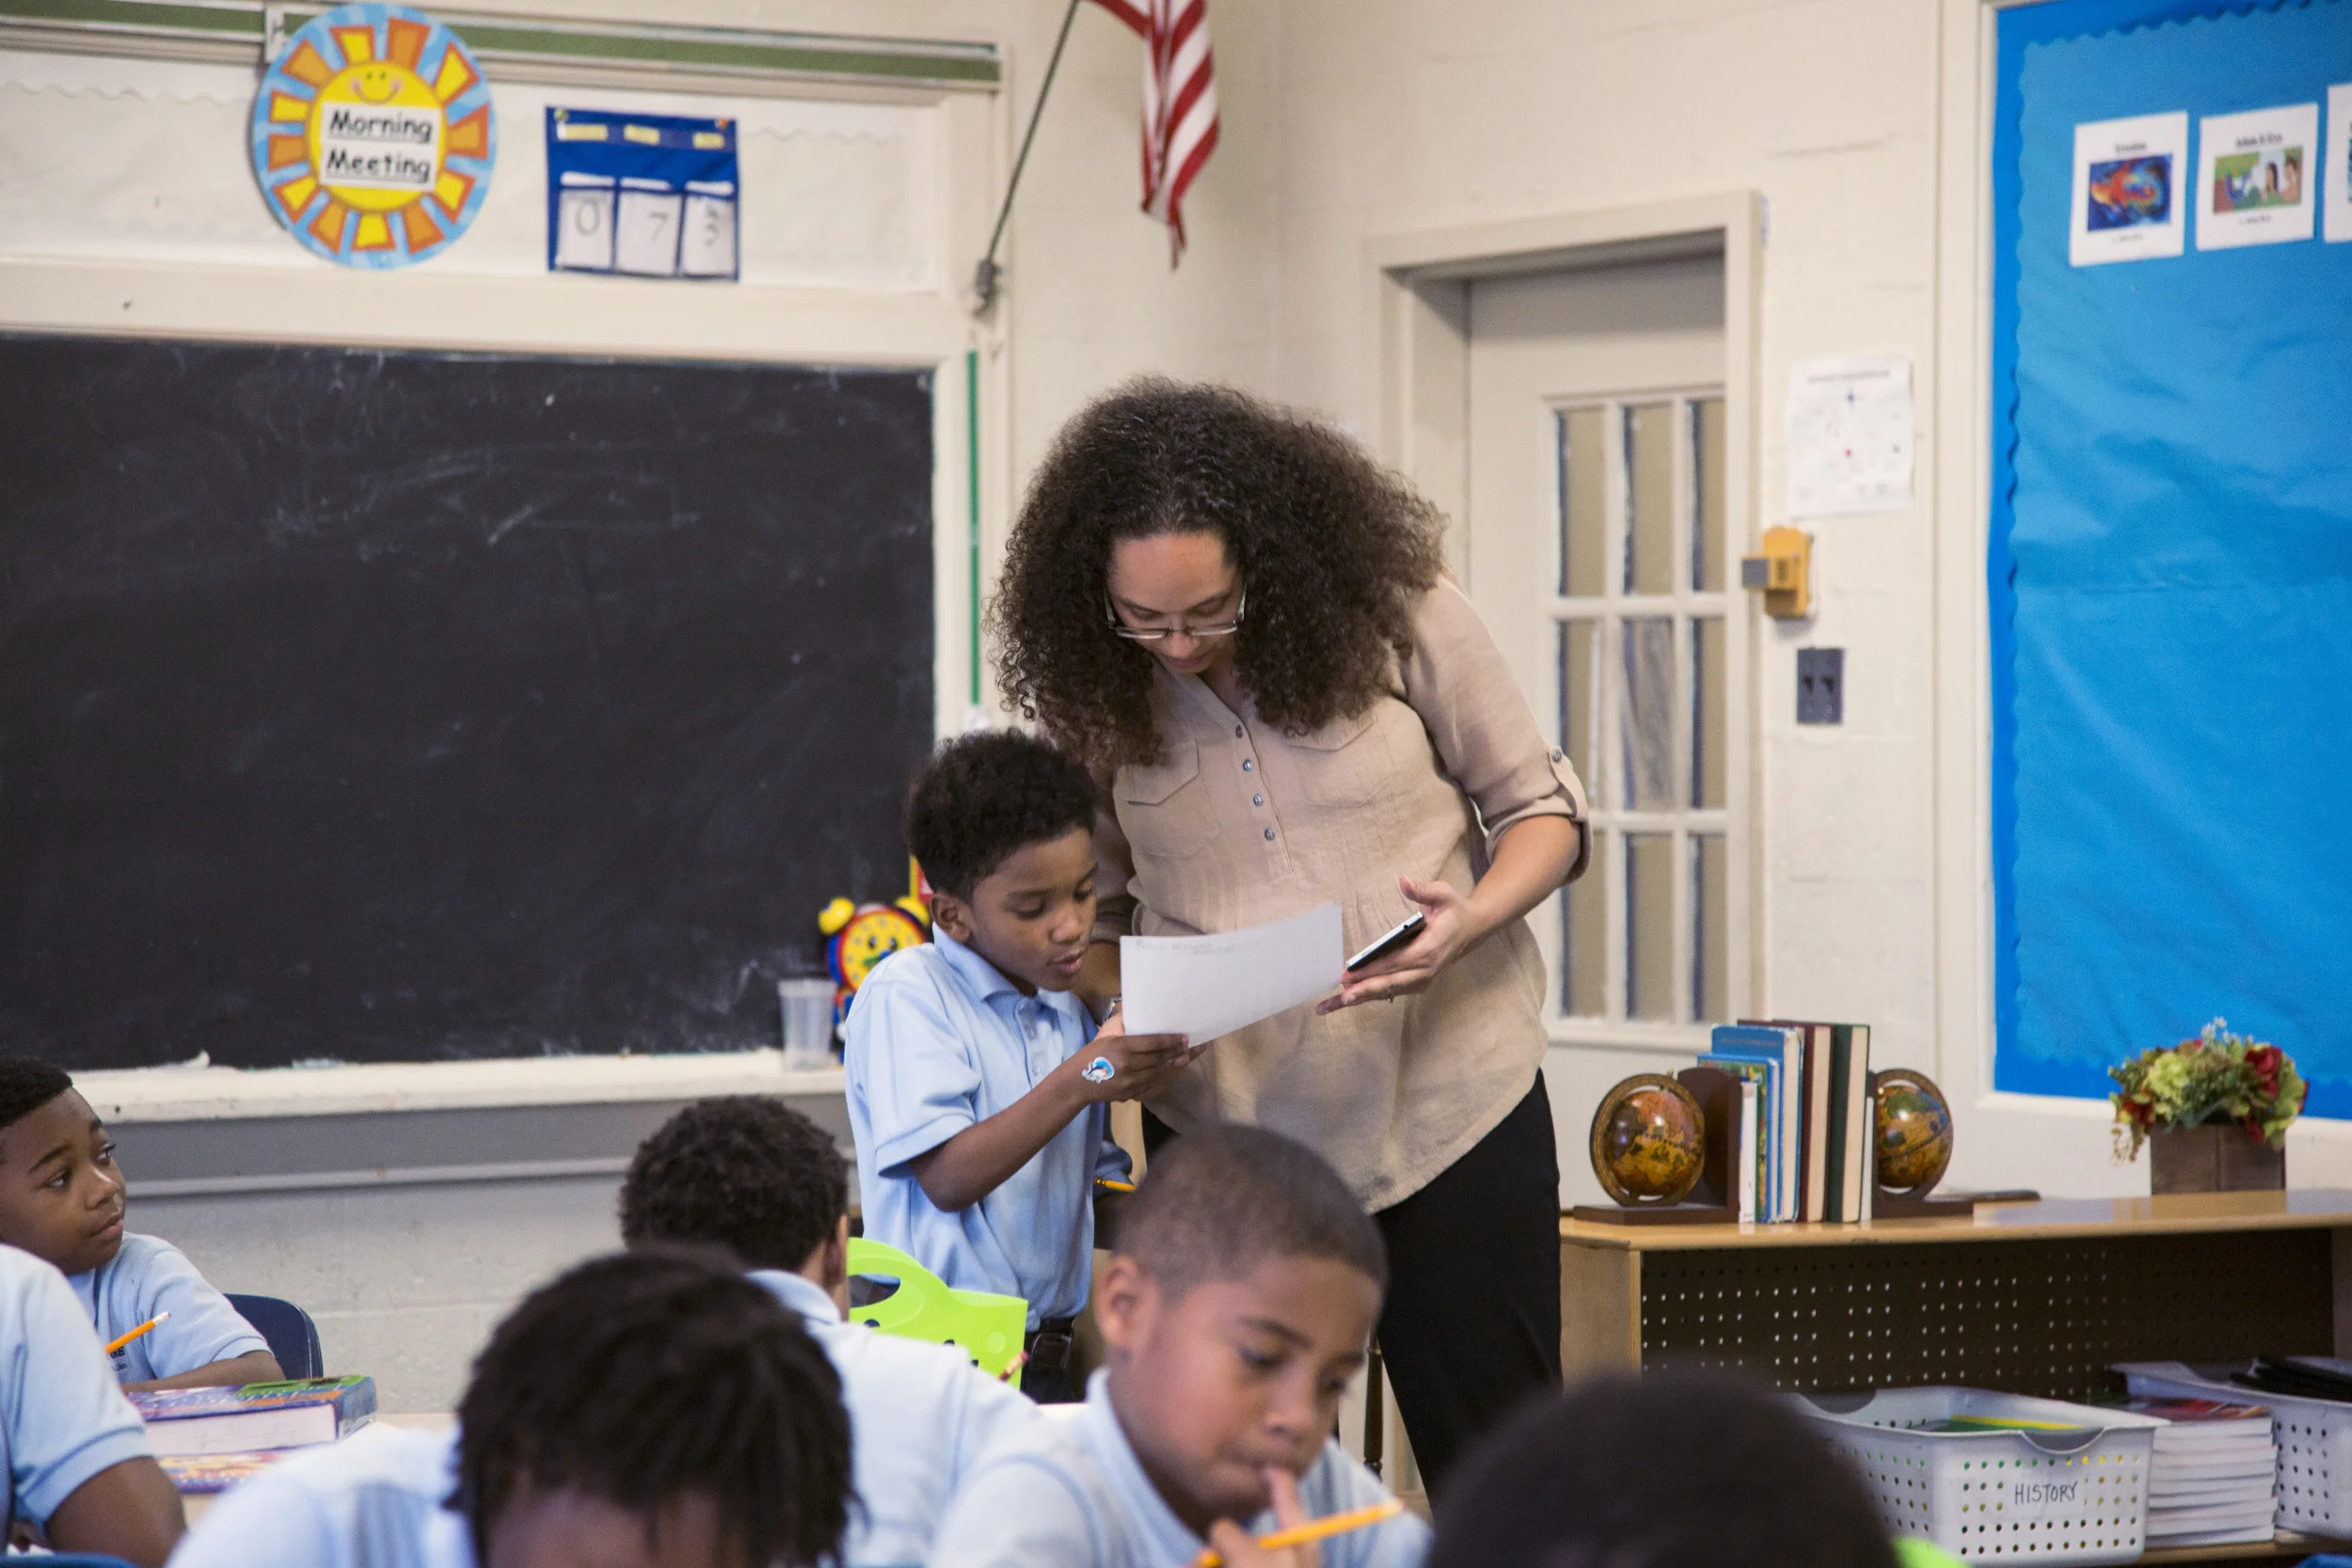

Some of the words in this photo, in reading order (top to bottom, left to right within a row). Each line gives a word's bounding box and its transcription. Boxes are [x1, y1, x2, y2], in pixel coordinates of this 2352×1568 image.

[329, 109, 432, 143] Morning
[326, 148, 431, 183] Meeting
[2014, 1480, 2078, 1505] HISTORY
